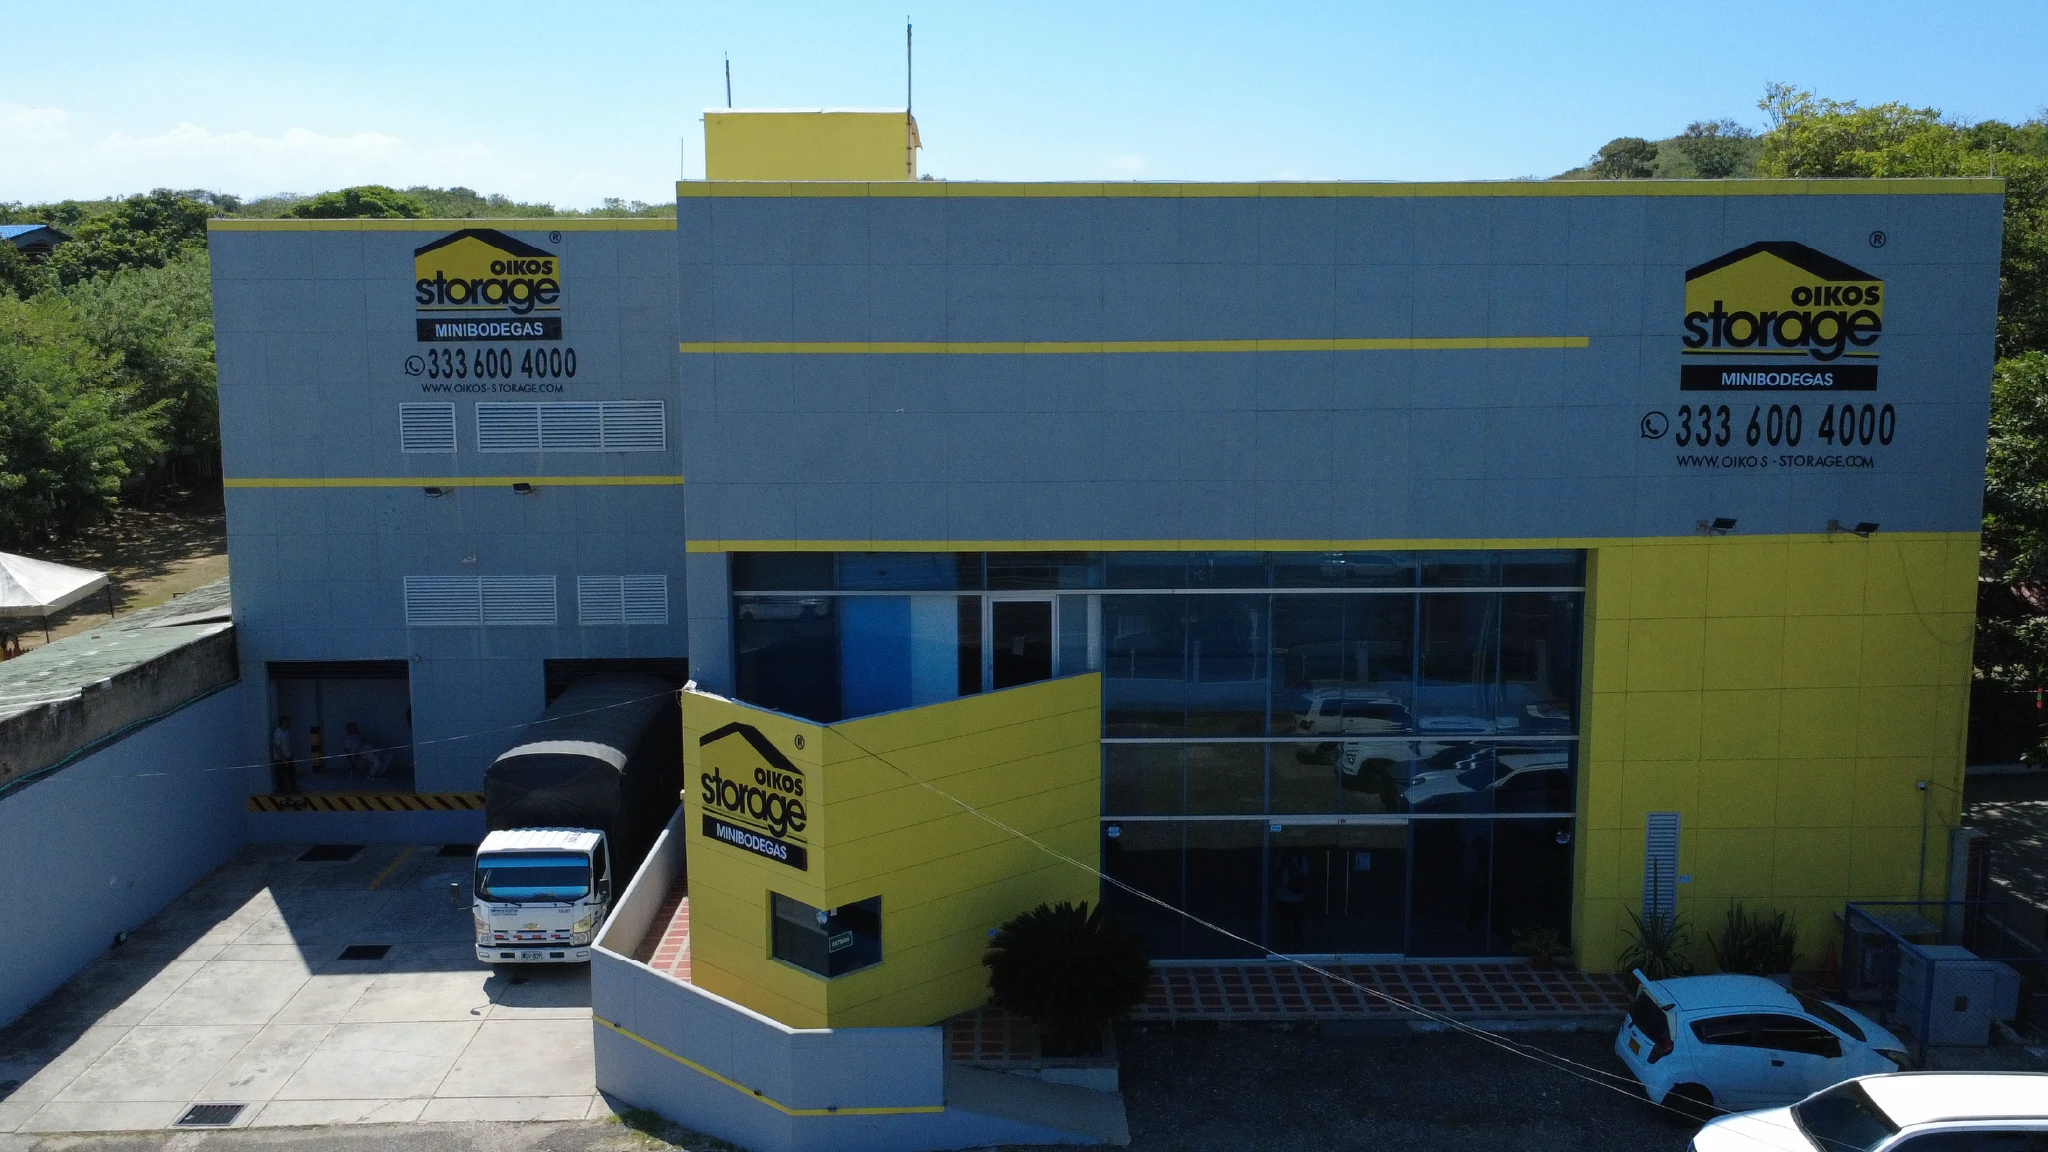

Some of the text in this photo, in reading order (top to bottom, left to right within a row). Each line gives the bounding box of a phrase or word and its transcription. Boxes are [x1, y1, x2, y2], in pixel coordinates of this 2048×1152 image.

[490, 259, 553, 275] OIKOS
[415, 270, 560, 315] storage
[1791, 286, 1880, 306] OIKOS
[435, 322, 544, 337] MINIBODEGAS
[1682, 300, 1882, 361] storage
[427, 347, 577, 379] 333 600 4000
[1721, 372, 1834, 386] MINIBODEGAS
[1675, 403, 1895, 447] 333 600 4000
[754, 767, 804, 797] OIKOS
[701, 766, 806, 838] storage
[716, 822, 787, 860] MINIBODEGAS
